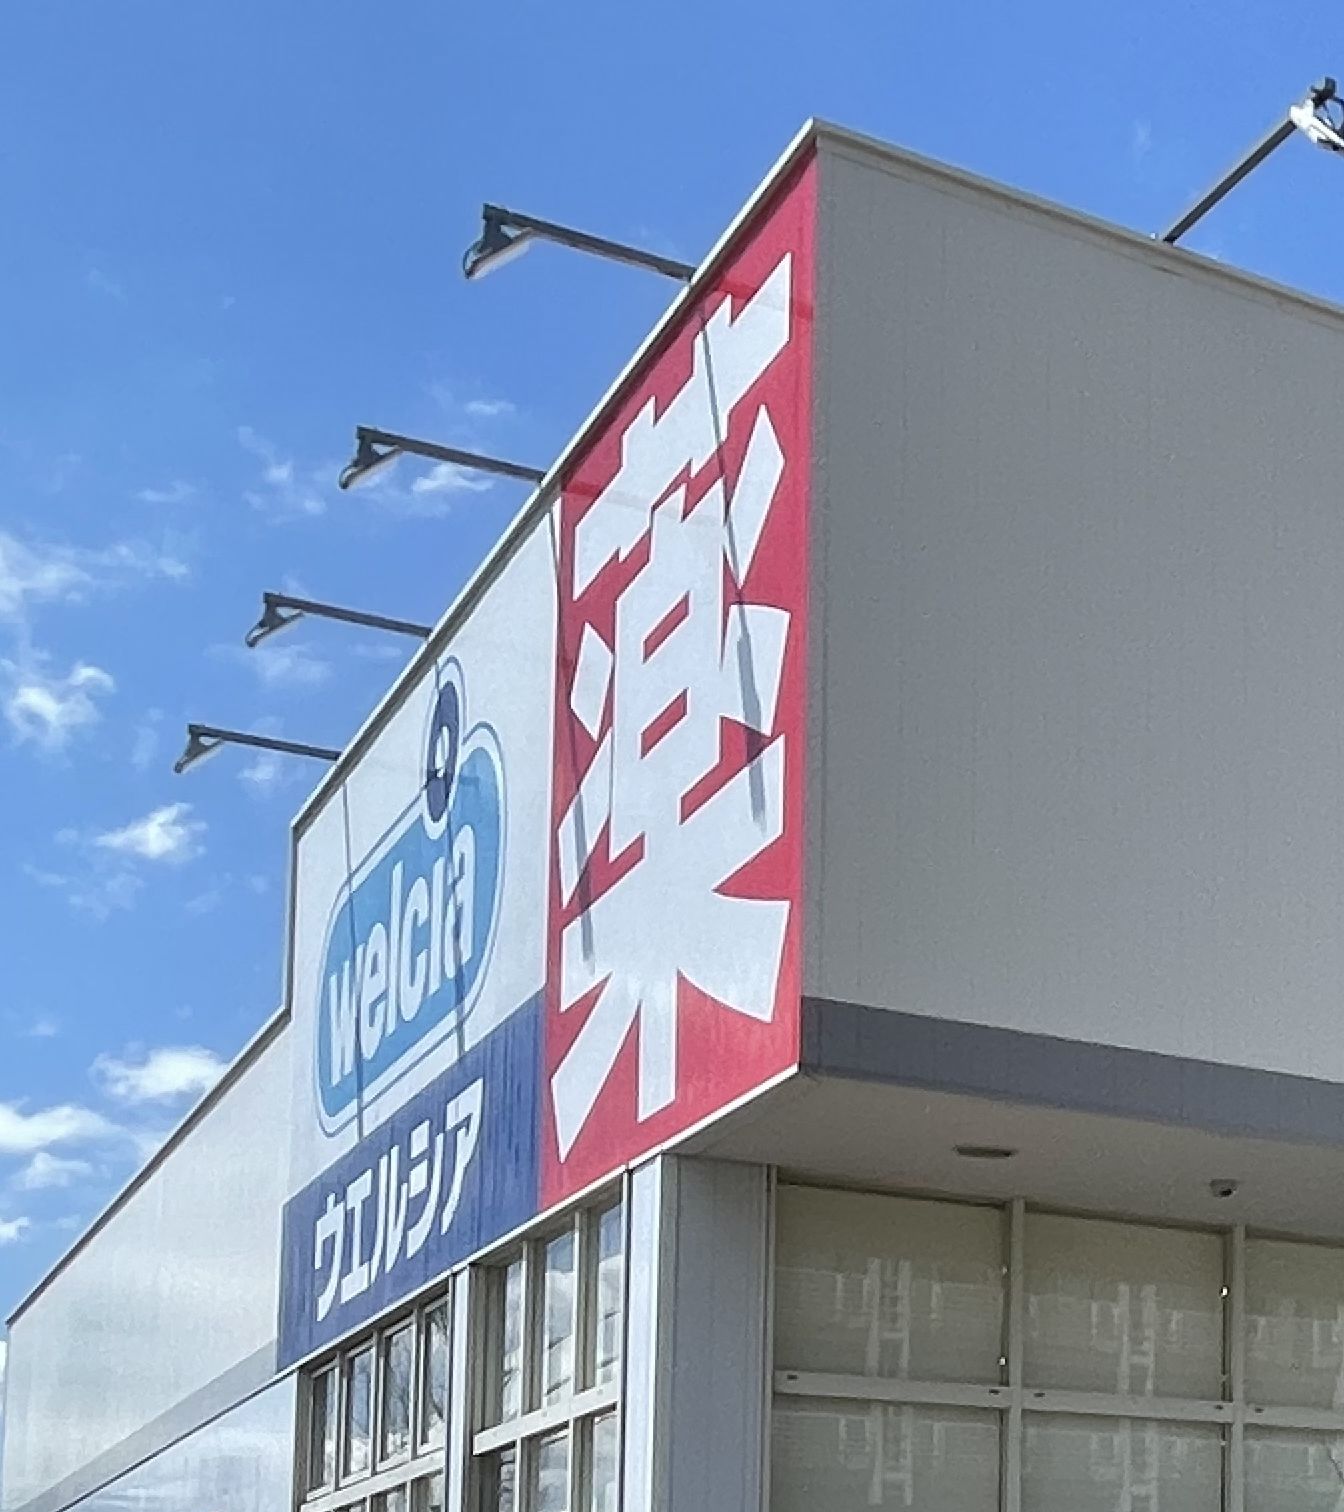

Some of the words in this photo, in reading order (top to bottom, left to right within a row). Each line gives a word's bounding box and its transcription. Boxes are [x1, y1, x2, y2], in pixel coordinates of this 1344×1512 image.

[327, 679, 476, 1085] welcia
[549, 251, 792, 1163] 薬
[314, 1076, 485, 1323] ウエルシア
